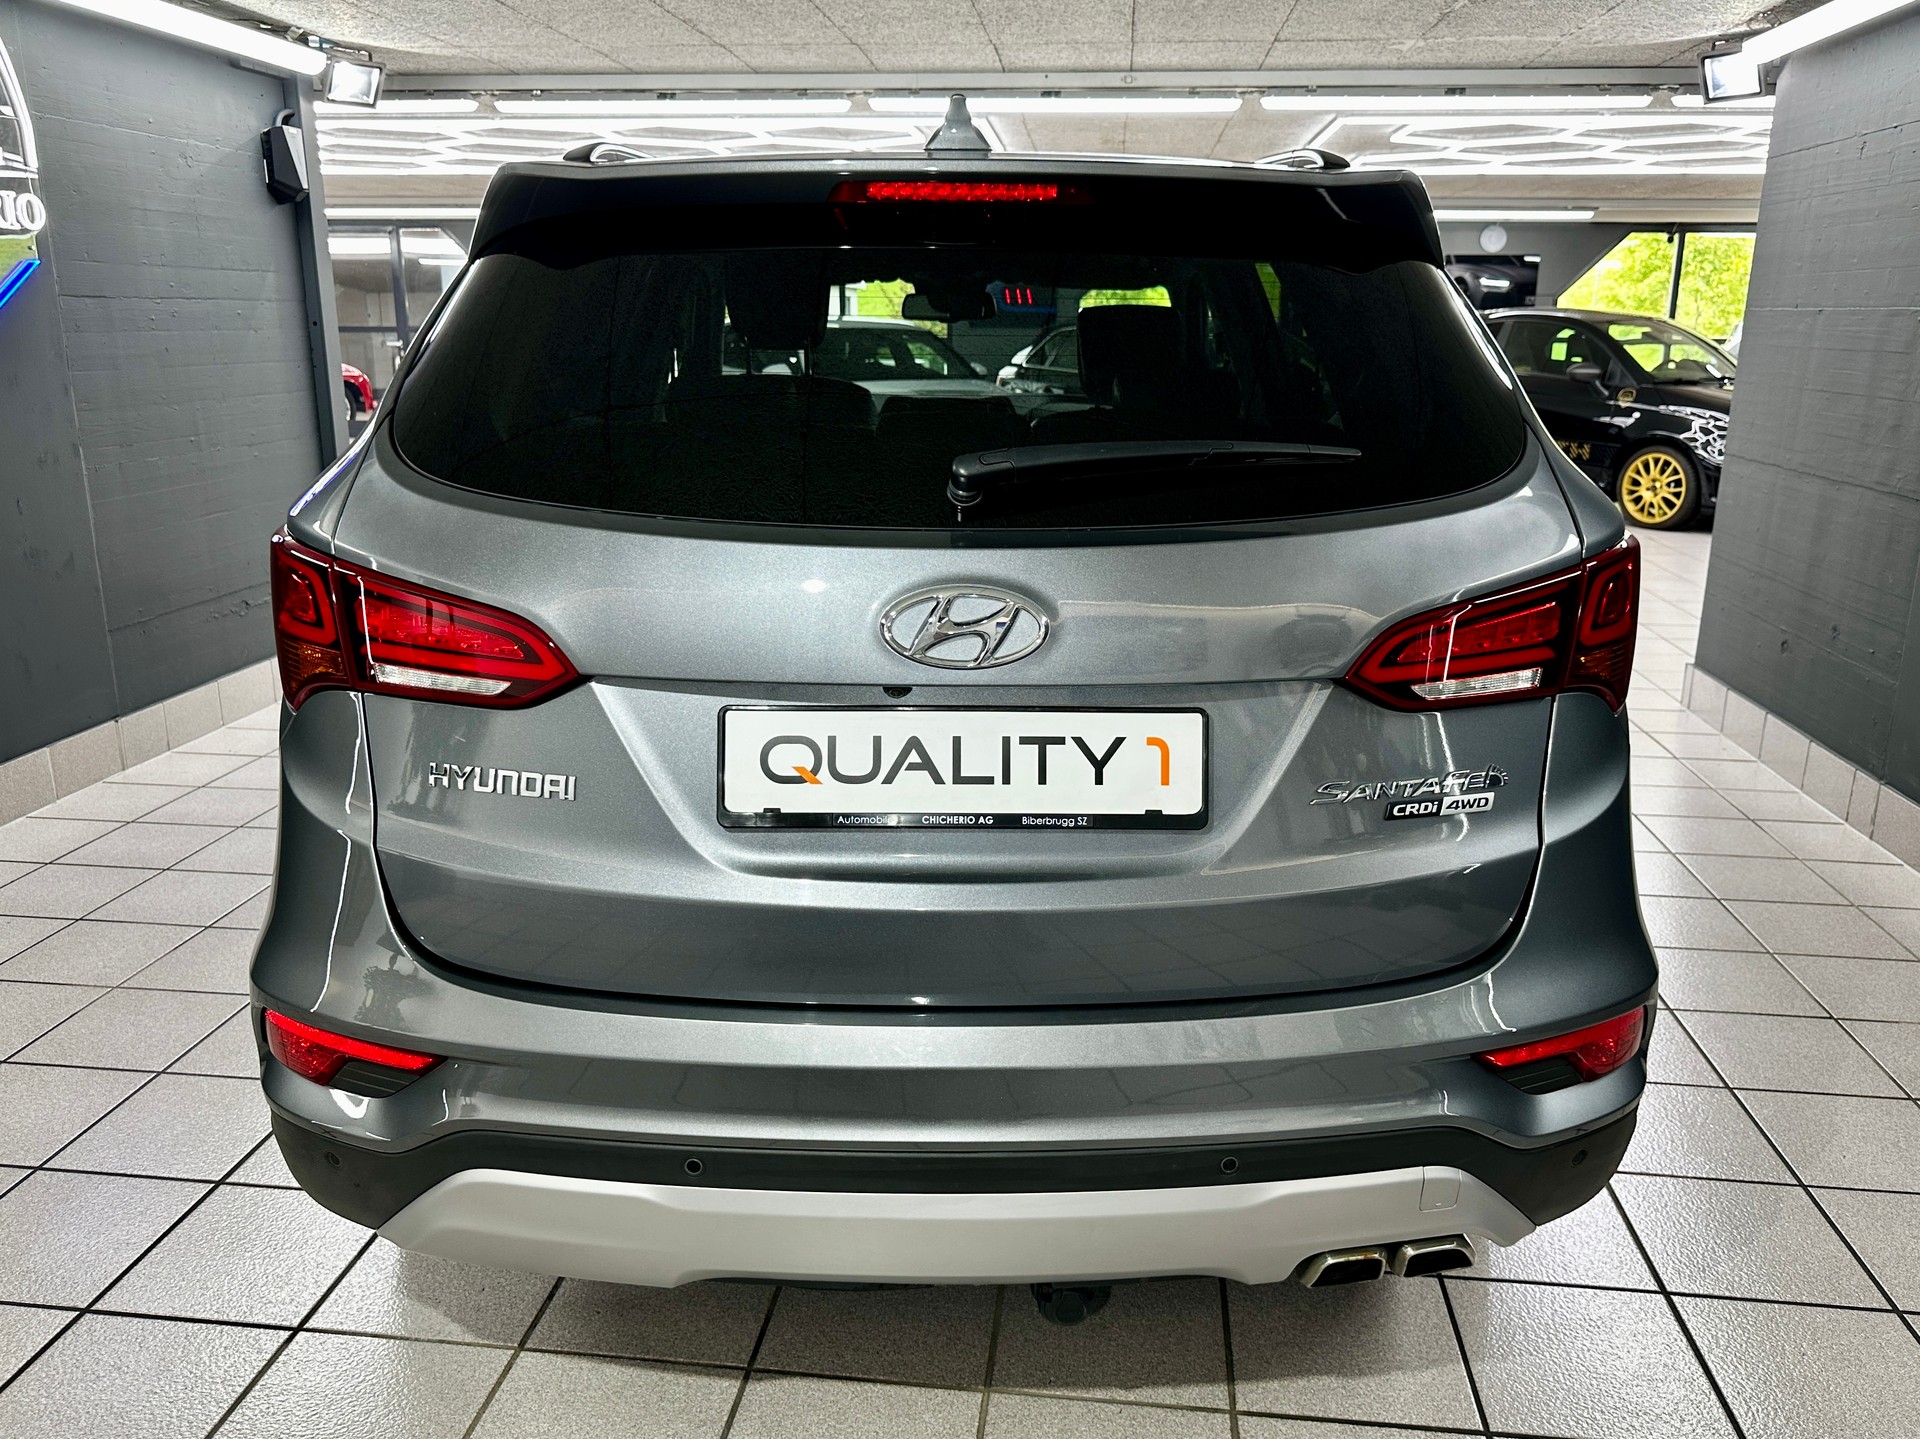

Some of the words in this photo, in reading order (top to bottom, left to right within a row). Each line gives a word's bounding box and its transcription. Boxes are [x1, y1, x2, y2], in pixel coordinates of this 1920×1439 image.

[759, 735, 1127, 786] QUALITY
[1146, 736, 1170, 786] 1
[428, 762, 576, 801] HYUNDAI
[921, 815, 976, 825] CHICHERIO
[977, 815, 994, 825] AG
[1021, 815, 1075, 828] Biberbrugg
[1077, 815, 1088, 826] SZ
[1392, 801, 1439, 817] CRDi
[1448, 797, 1489, 812] 4WD
